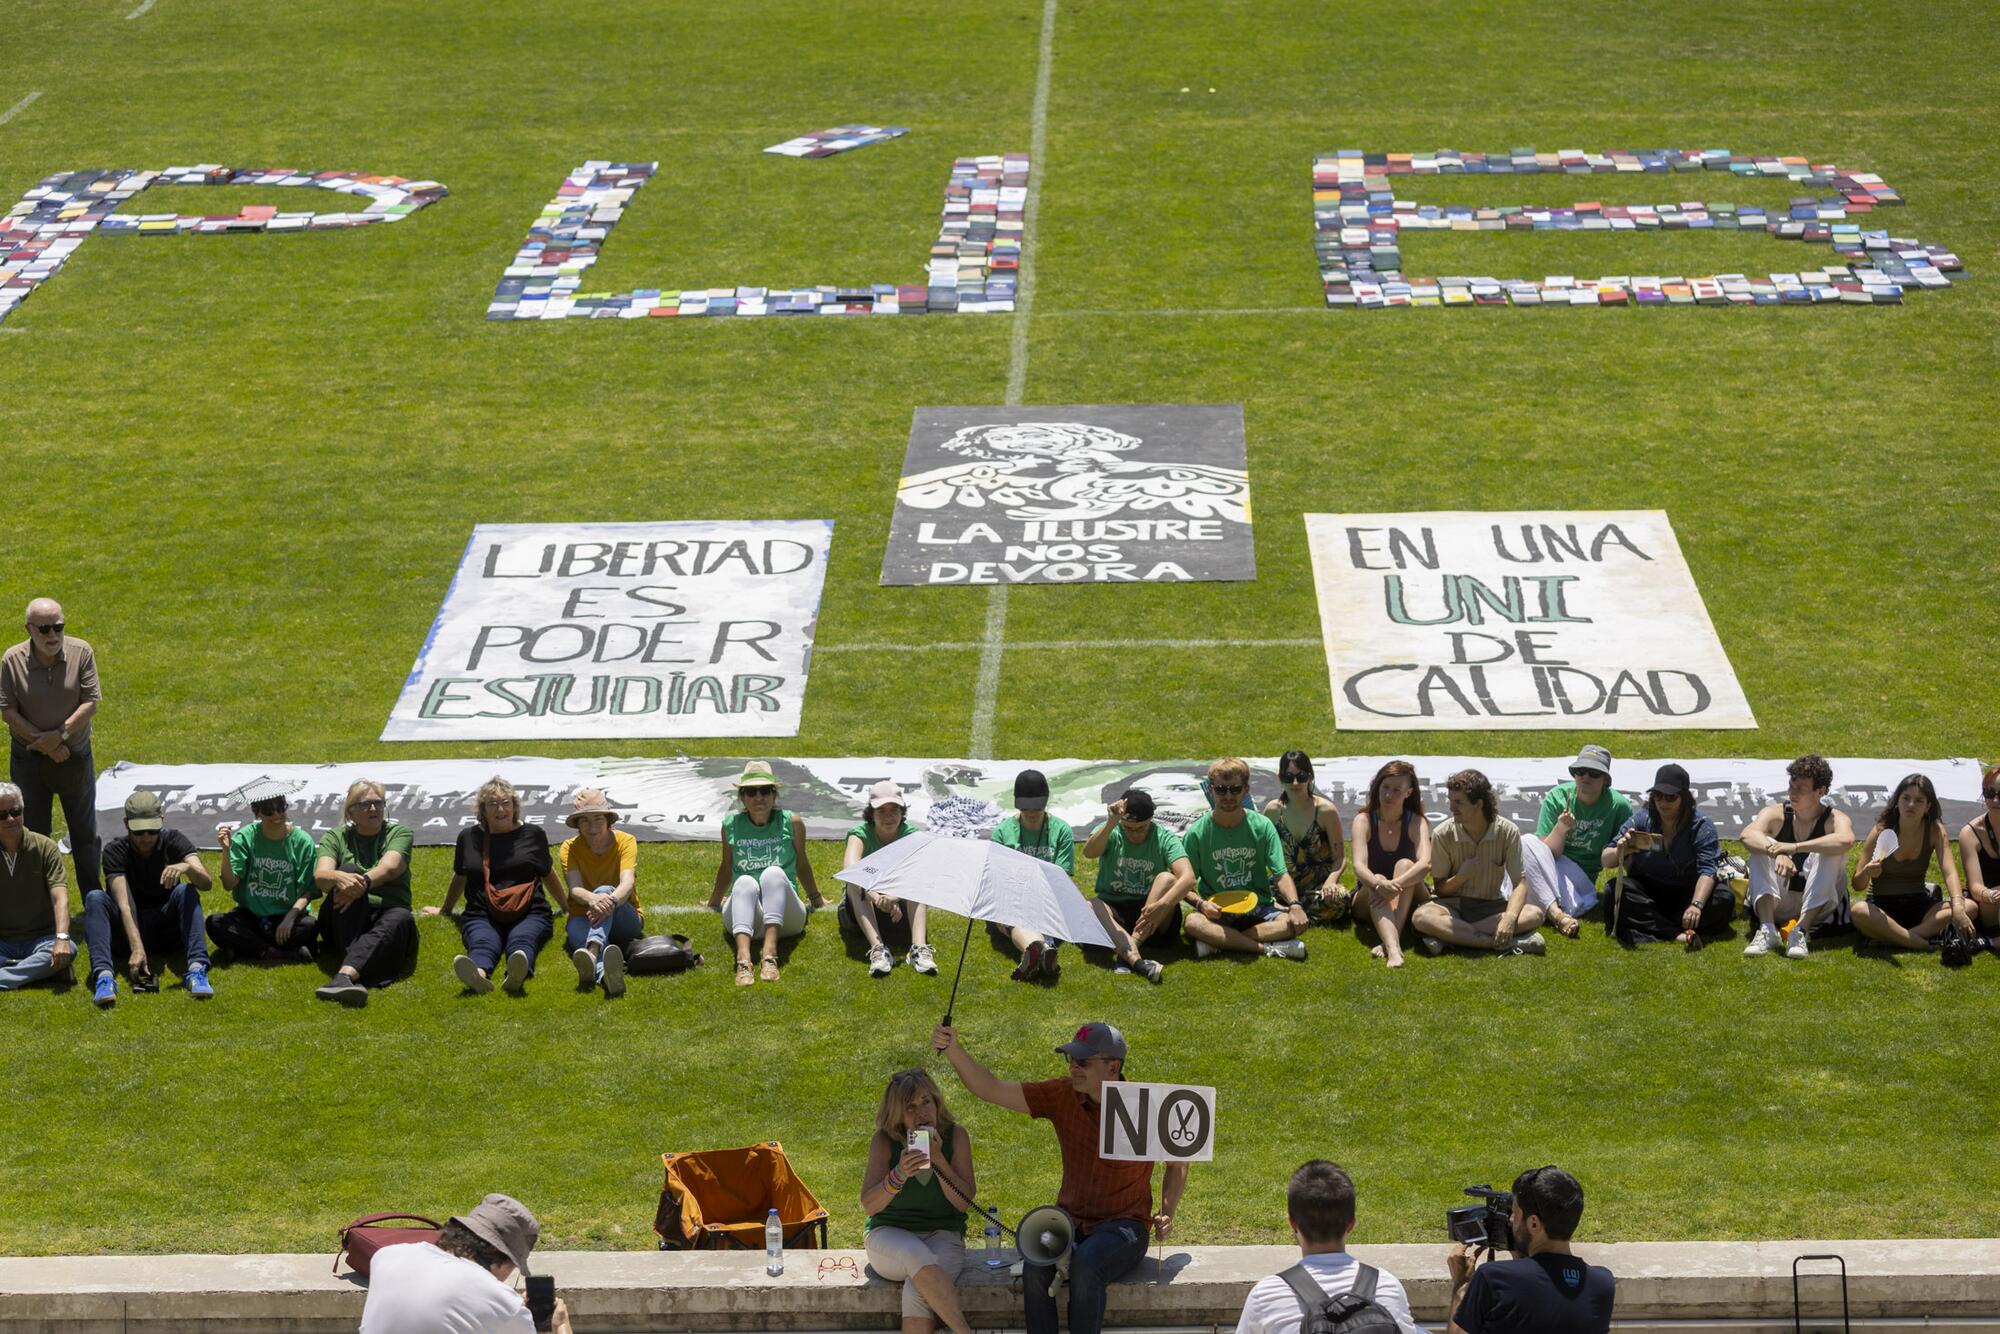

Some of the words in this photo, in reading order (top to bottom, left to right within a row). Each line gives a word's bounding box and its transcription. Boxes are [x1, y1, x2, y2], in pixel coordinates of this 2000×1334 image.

[916, 521, 1004, 545] LA
[1023, 519, 1225, 543] ILUSTRE
[1345, 525, 1441, 570] EN
[1490, 523, 1655, 564] UNA
[482, 539, 815, 579] LIBERTAD
[927, 561, 1195, 584] DEVORA
[1003, 544, 1123, 563] NOS
[561, 585, 688, 619] ES
[1383, 574, 1594, 626] UNI
[465, 620, 783, 672] PODER
[1443, 630, 1571, 666] DE
[1342, 663, 1713, 718] CALIDAD
[1211, 846, 1257, 861] UNIVERSIDAD
[1103, 1086, 1211, 1158] NO
